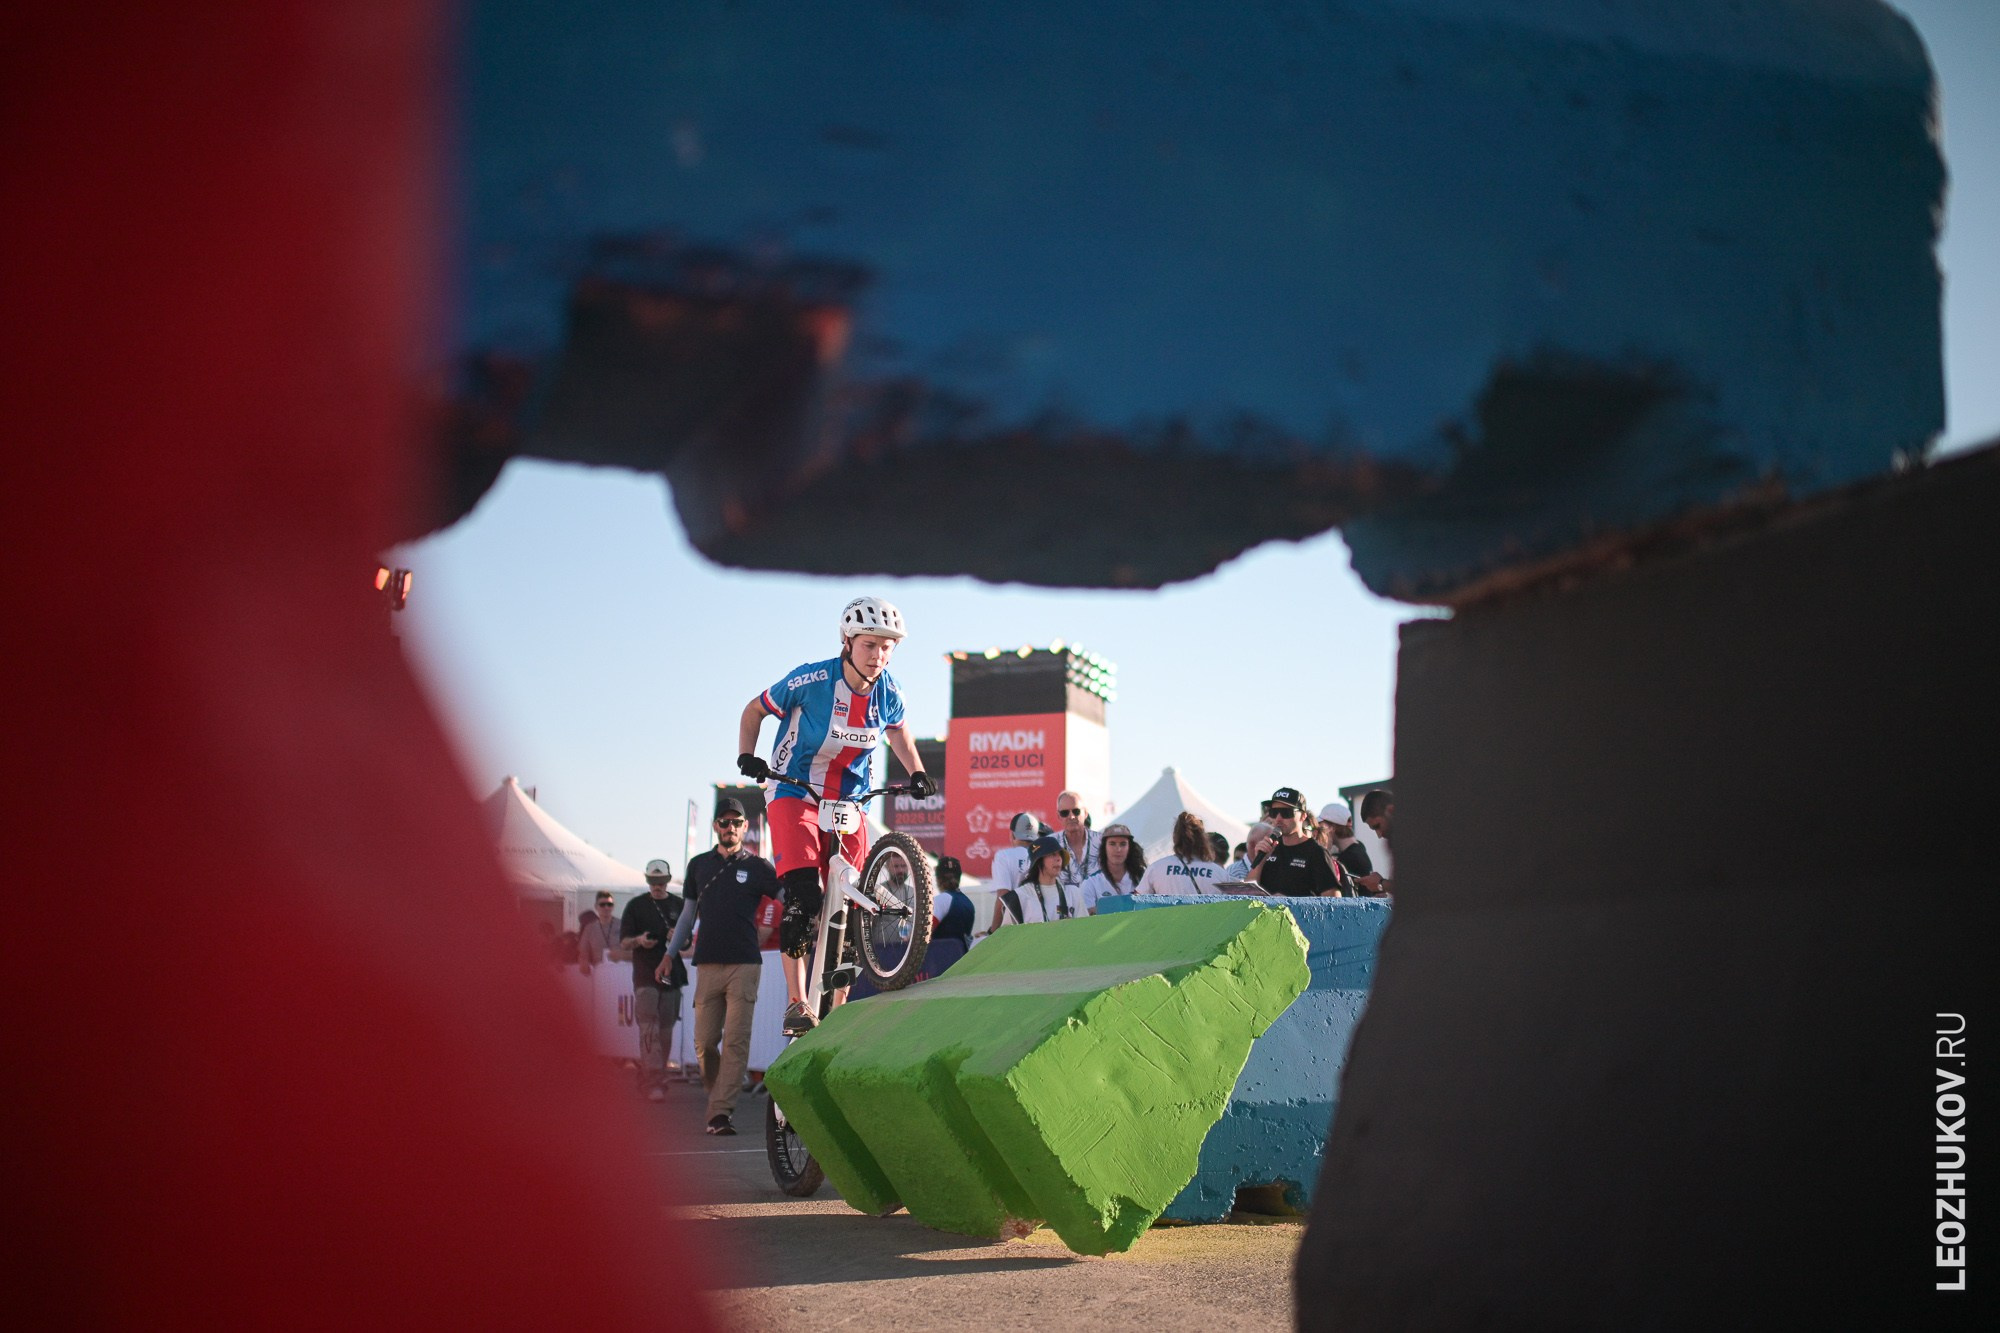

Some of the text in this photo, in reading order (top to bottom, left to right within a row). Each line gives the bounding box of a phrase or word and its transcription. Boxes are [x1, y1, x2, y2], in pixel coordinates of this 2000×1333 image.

[969, 730, 1044, 752] RIYADH
[970, 753, 1044, 769] 2025 UCI
[834, 812, 849, 825] 5E
[1166, 865, 1213, 879] FRANCE
